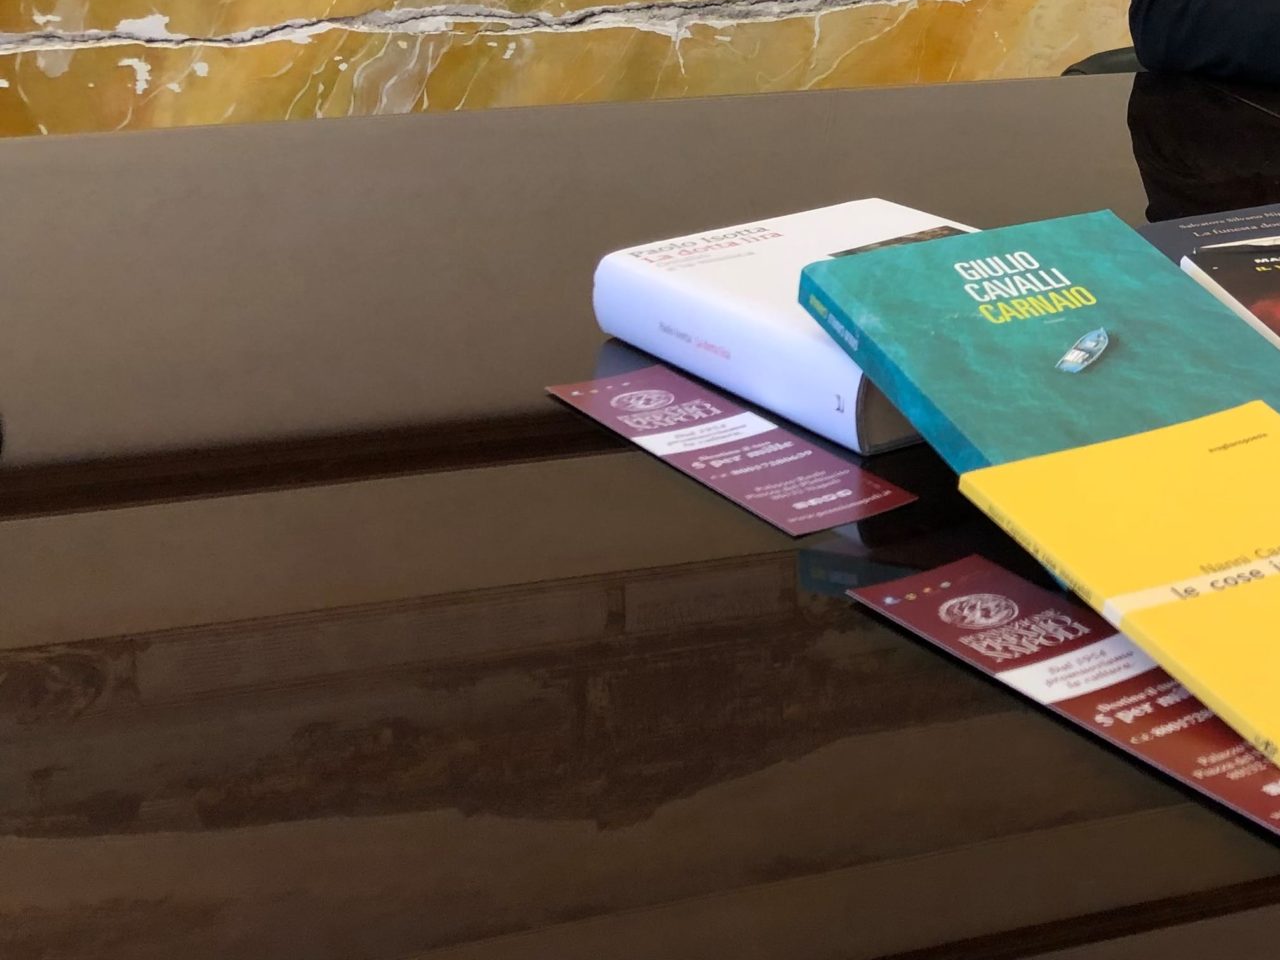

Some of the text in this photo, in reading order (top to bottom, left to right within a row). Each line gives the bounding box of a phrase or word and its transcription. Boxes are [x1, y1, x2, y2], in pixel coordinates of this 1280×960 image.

[1179, 220, 1224, 228] Salvatore
[1226, 215, 1263, 223] Silvano
[629, 226, 768, 258] Paolo Isotta
[641, 254, 672, 263] La
[678, 241, 738, 256] dotta
[741, 231, 784, 243] lira
[954, 251, 1040, 280] GIULIO
[964, 268, 1072, 302] CAVALLI
[978, 286, 1097, 324] CARNAIO
[709, 455, 741, 468] per
[746, 441, 795, 458] mille
[1199, 554, 1251, 575] Nanni
[1171, 585, 1200, 601] le
[1209, 567, 1265, 591] cose
[1095, 701, 1154, 727] 5 per
